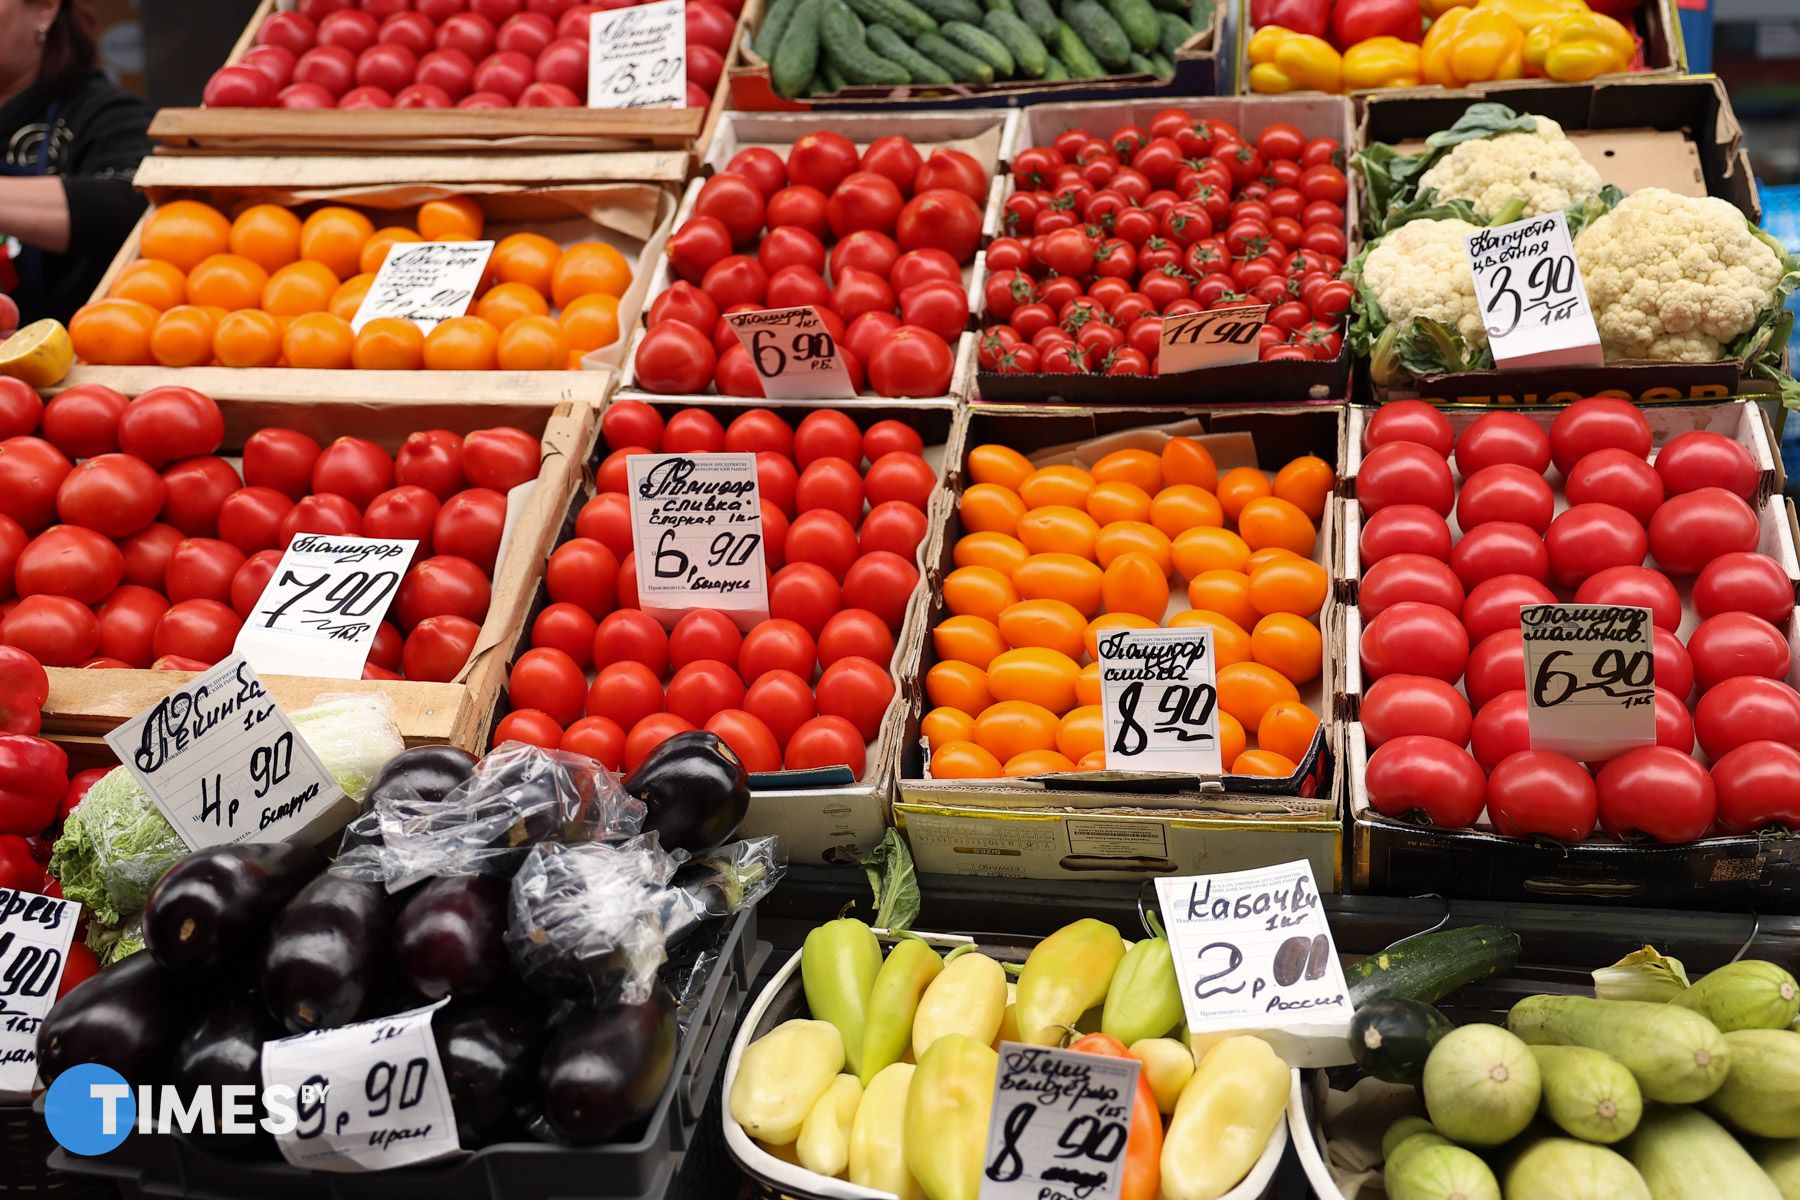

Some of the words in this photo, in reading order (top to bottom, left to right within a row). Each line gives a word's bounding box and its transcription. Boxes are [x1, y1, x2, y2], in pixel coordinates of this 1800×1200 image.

[1487, 265, 1522, 338] 3
[1528, 255, 1575, 302] 90
[753, 329, 787, 378] 6
[792, 332, 835, 361] 90
[1163, 316, 1218, 345] 11
[1205, 321, 1263, 344] 90
[639, 457, 755, 498] Помидор
[292, 536, 404, 564] Помидор
[707, 531, 761, 567] 90
[261, 570, 332, 629] 7
[302, 571, 400, 617] 90
[690, 576, 751, 594] Беларусь
[1520, 605, 1649, 630] Помидор
[1534, 650, 1579, 708] 6
[1586, 648, 1656, 687] 90
[135, 661, 266, 774] Пекинка
[1113, 681, 1148, 756] 8
[1154, 683, 1217, 726] 90
[250, 731, 294, 799] 90
[259, 782, 320, 832] Беларусь
[1187, 876, 1318, 920] Кабачки
[0, 945, 62, 997] 90
[1266, 995, 1344, 1013] Россия
[365, 1056, 430, 1118] 90
[985, 1102, 1038, 1182] 8
[1053, 1115, 1128, 1163] 90
